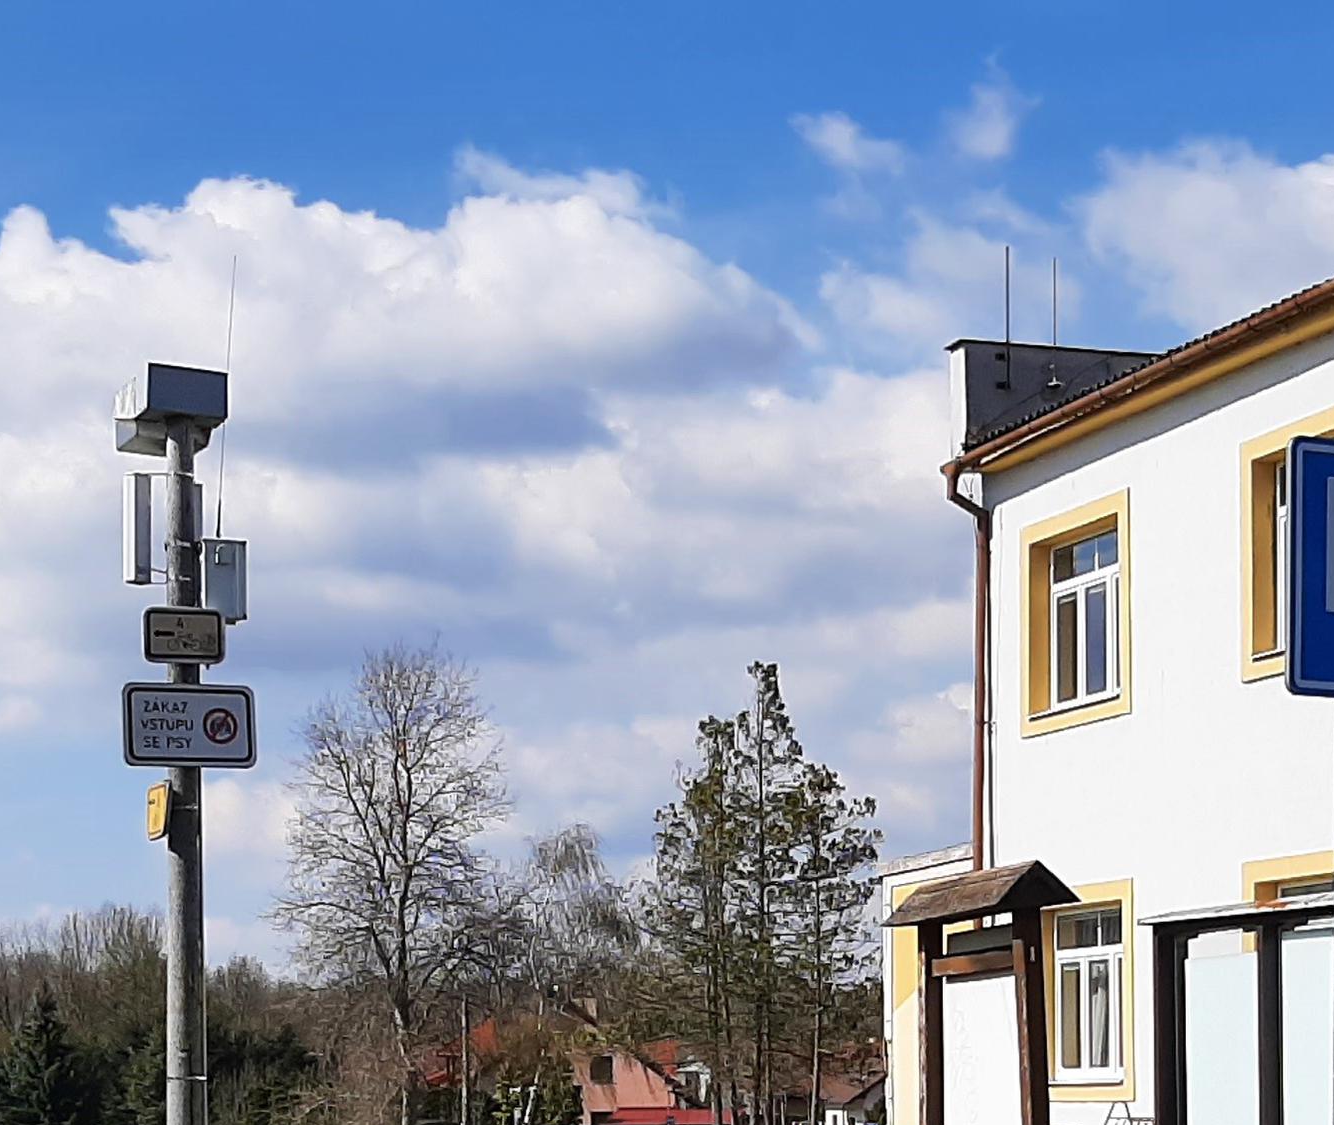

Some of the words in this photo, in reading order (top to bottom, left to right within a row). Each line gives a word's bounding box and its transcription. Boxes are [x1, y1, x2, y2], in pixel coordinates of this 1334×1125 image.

[143, 696, 188, 714] ZÁKAZ
[140, 718, 194, 731] VSTUPU
[143, 735, 160, 749] SE
[166, 736, 192, 749] PSY
